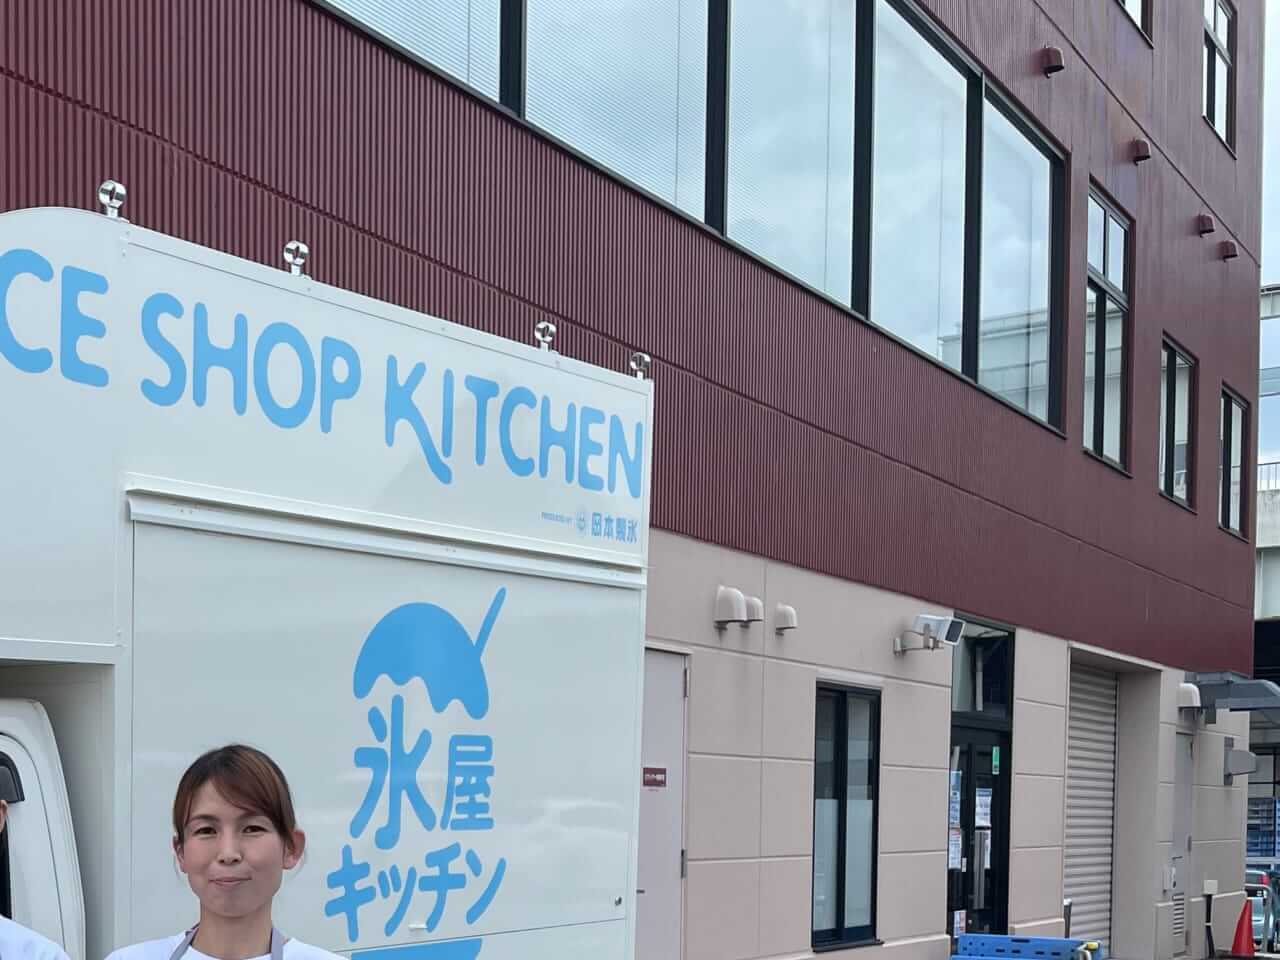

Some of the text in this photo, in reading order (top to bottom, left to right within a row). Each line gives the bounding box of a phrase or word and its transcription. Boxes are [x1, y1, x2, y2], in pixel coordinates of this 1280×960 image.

[140, 292, 361, 434] SHOP
[384, 354, 644, 498] KITCHEN
[350, 694, 494, 850] 氷屋
[324, 842, 507, 942] キッチン
